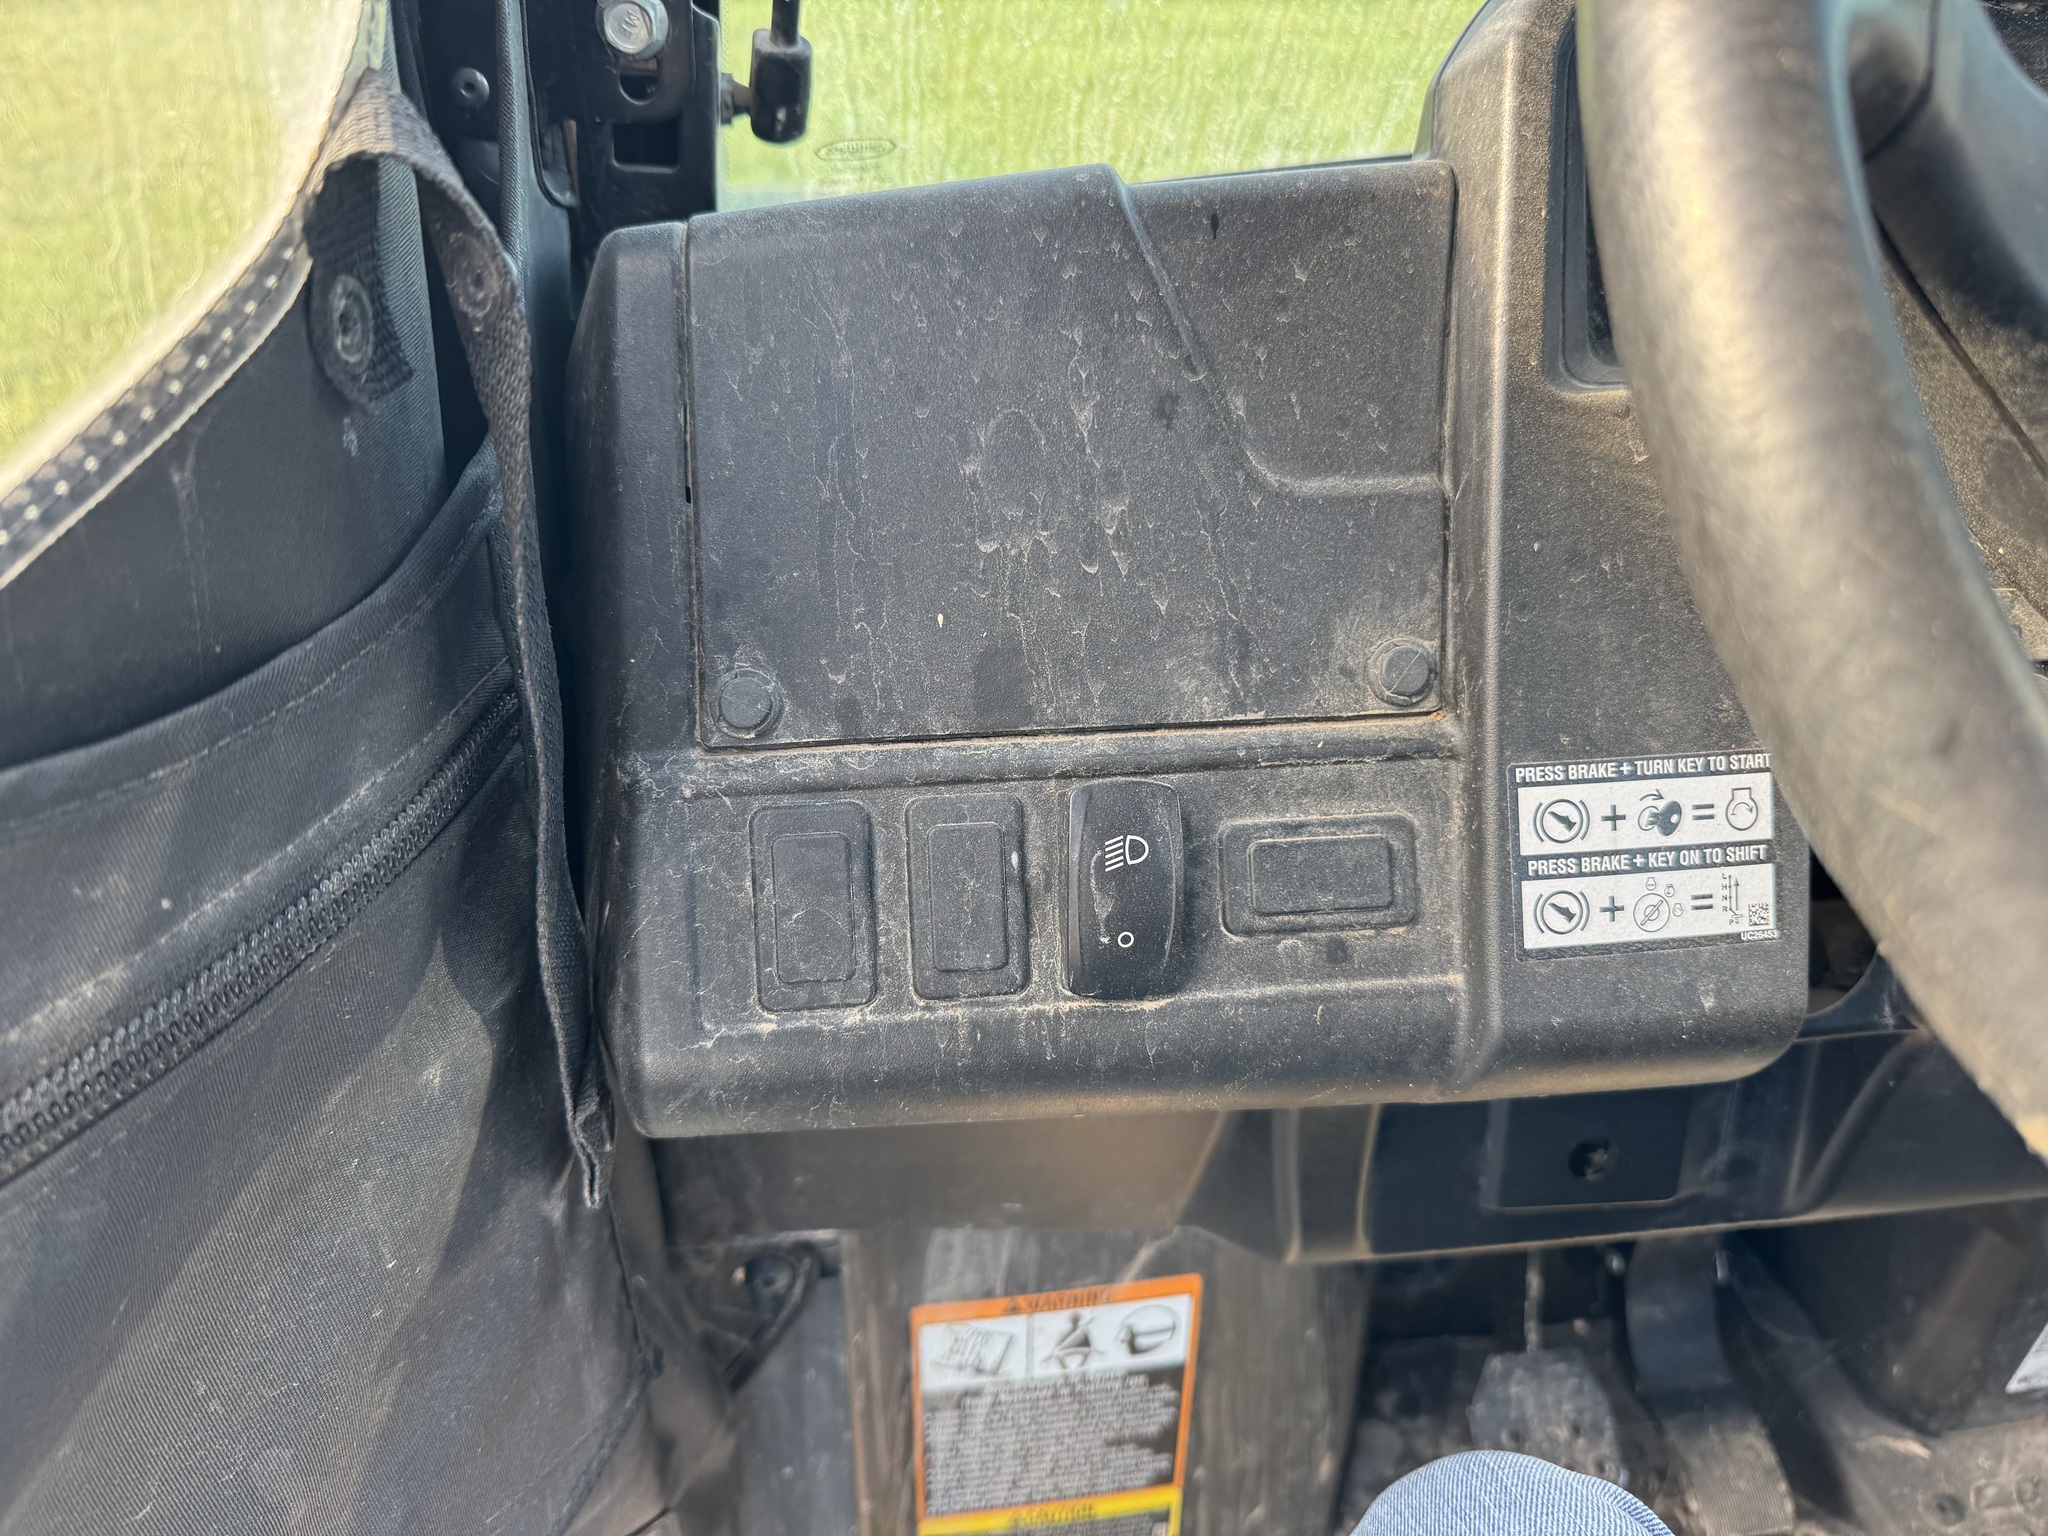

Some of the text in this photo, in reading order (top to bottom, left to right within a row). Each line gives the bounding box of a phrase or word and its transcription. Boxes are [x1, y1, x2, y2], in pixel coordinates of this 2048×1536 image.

[1515, 765, 1564, 783] PRESS
[1568, 762, 1617, 780] BRAKE
[1634, 759, 1674, 776] TURN
[1677, 756, 1704, 773] KEY
[1706, 755, 1725, 772] TO
[1729, 752, 1772, 770] START
[1528, 858, 1578, 876] PRESS
[1581, 854, 1630, 873] BRAKE
[1648, 851, 1675, 868] KEY
[1679, 849, 1700, 866] ON
[1703, 847, 1722, 864] TO
[1726, 844, 1767, 862] SHIFT
